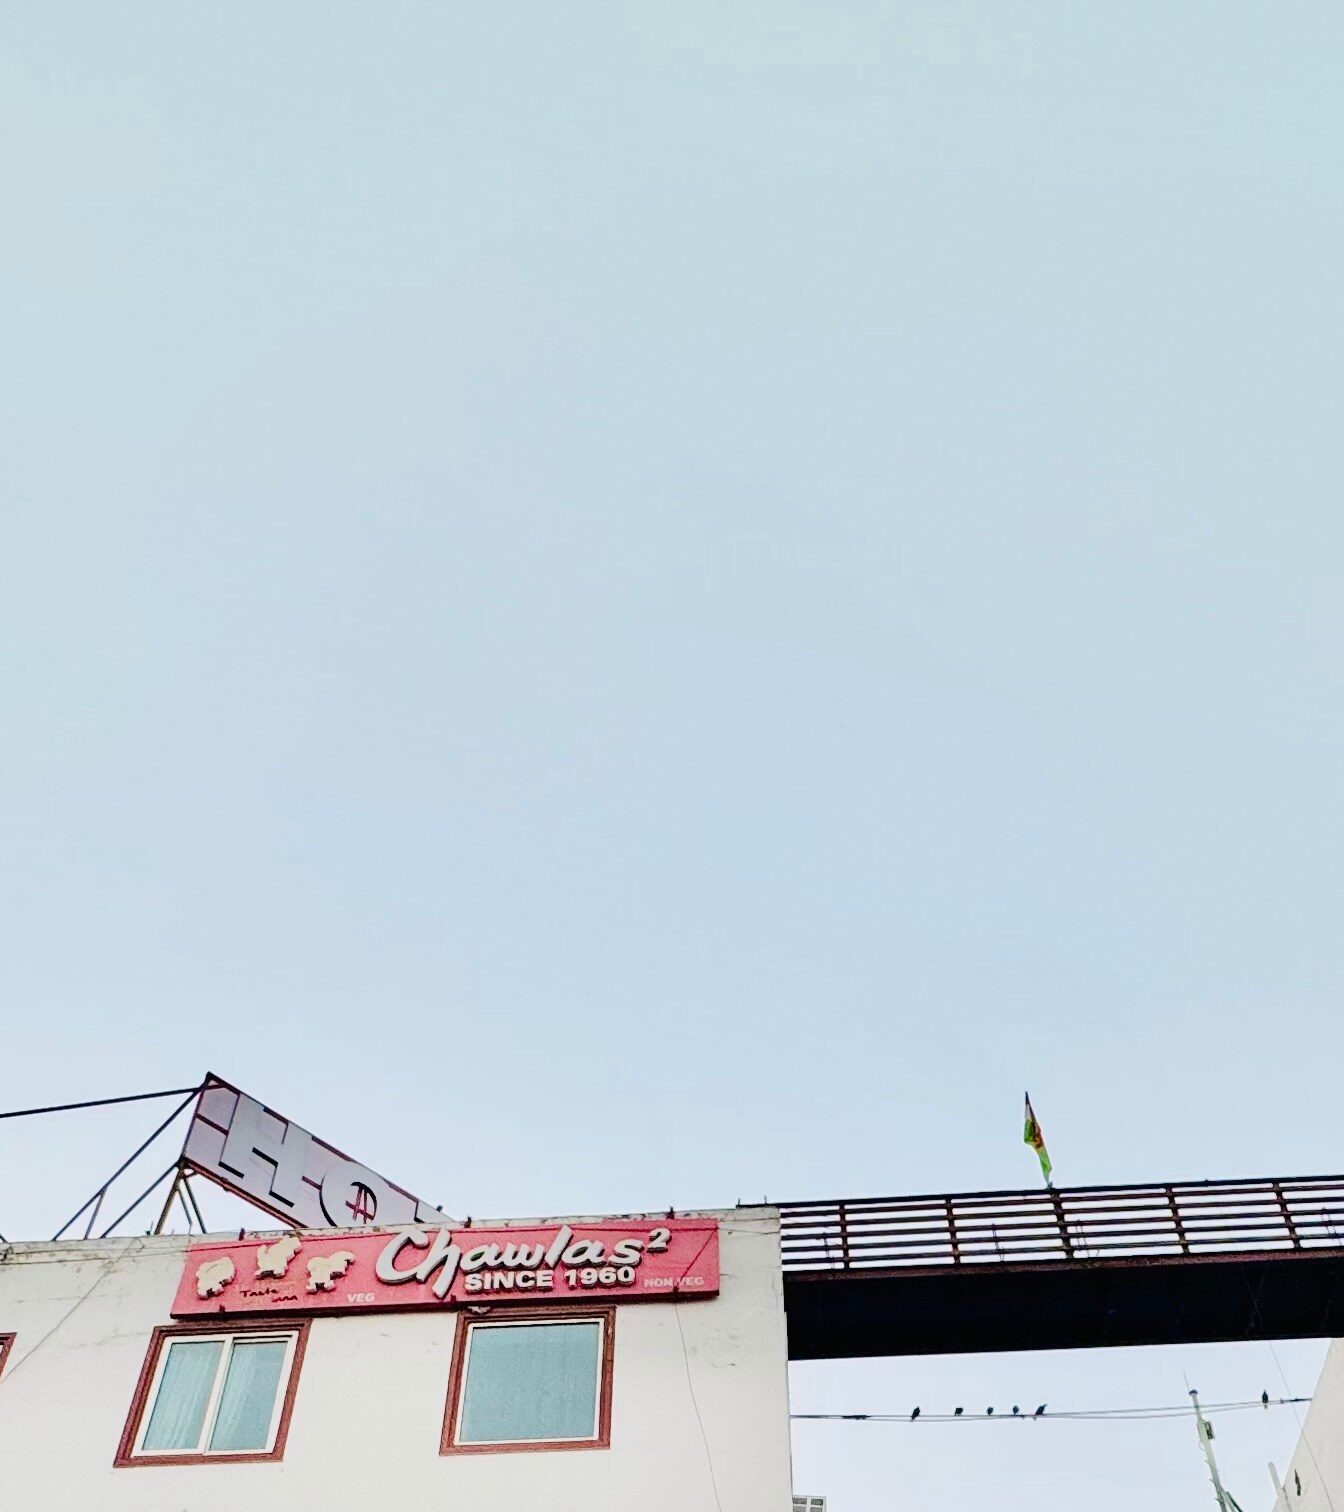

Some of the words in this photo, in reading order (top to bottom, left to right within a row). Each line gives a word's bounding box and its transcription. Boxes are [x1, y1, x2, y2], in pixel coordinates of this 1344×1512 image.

[465, 1268, 554, 1293] SINCE
[564, 1265, 637, 1288] 1960
[643, 1277, 671, 1289] NON
[347, 1292, 375, 1303] VEG
